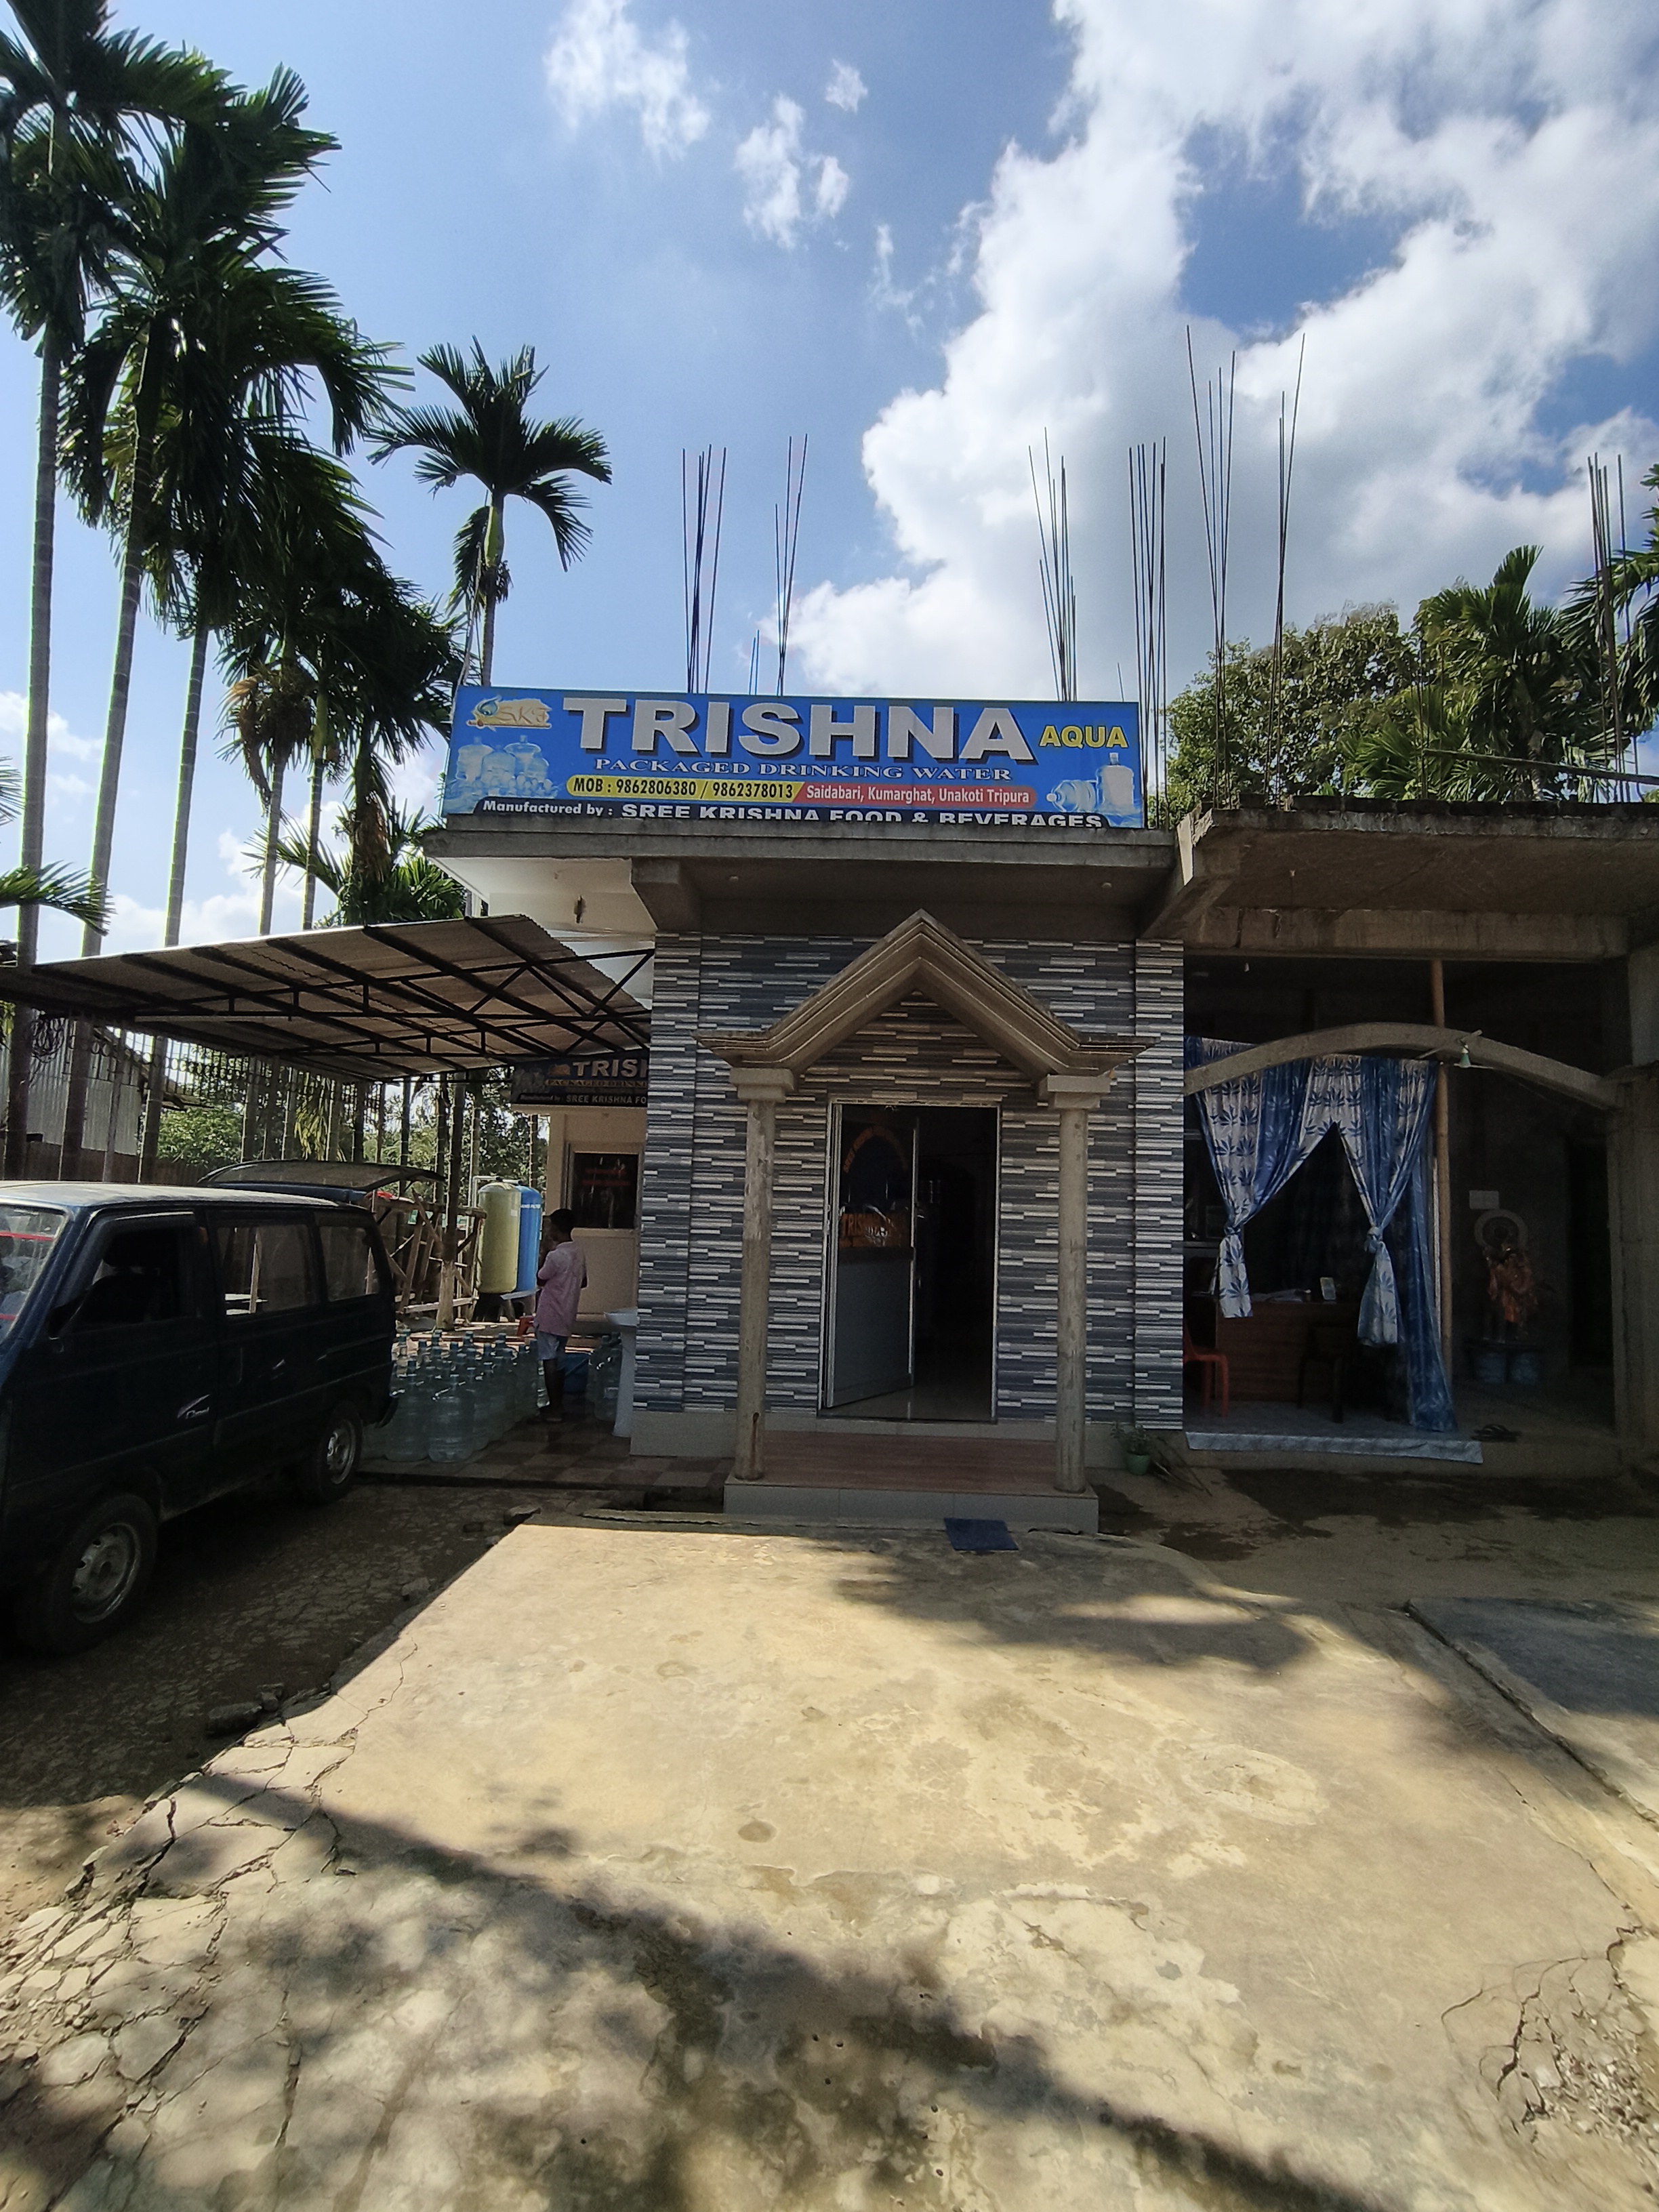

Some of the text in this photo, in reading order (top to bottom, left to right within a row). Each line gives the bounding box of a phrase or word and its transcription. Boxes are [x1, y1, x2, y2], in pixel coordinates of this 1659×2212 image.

[562, 697, 1129, 762] TRISHNA AQUA
[595, 758, 1013, 781] PACKAGED DRINKING WATER
[573, 777, 604, 792] MOB
[615, 780, 697, 796] 9862806380
[712, 782, 794, 799] 9862378013
[806, 785, 1029, 805] Saidabari, Kumarghat, Unakoti Tripura
[483, 800, 581, 814] Manufactured
[586, 804, 604, 817] by
[621, 804, 691, 819] SREE
[699, 806, 819, 821] KRISHNA
[830, 809, 902, 822] FOOD
[912, 812, 928, 823] &
[939, 812, 1103, 827] BEVERAGES
[566, 1094, 590, 1103] SREE
[592, 1095, 632, 1104] KRISHNA
